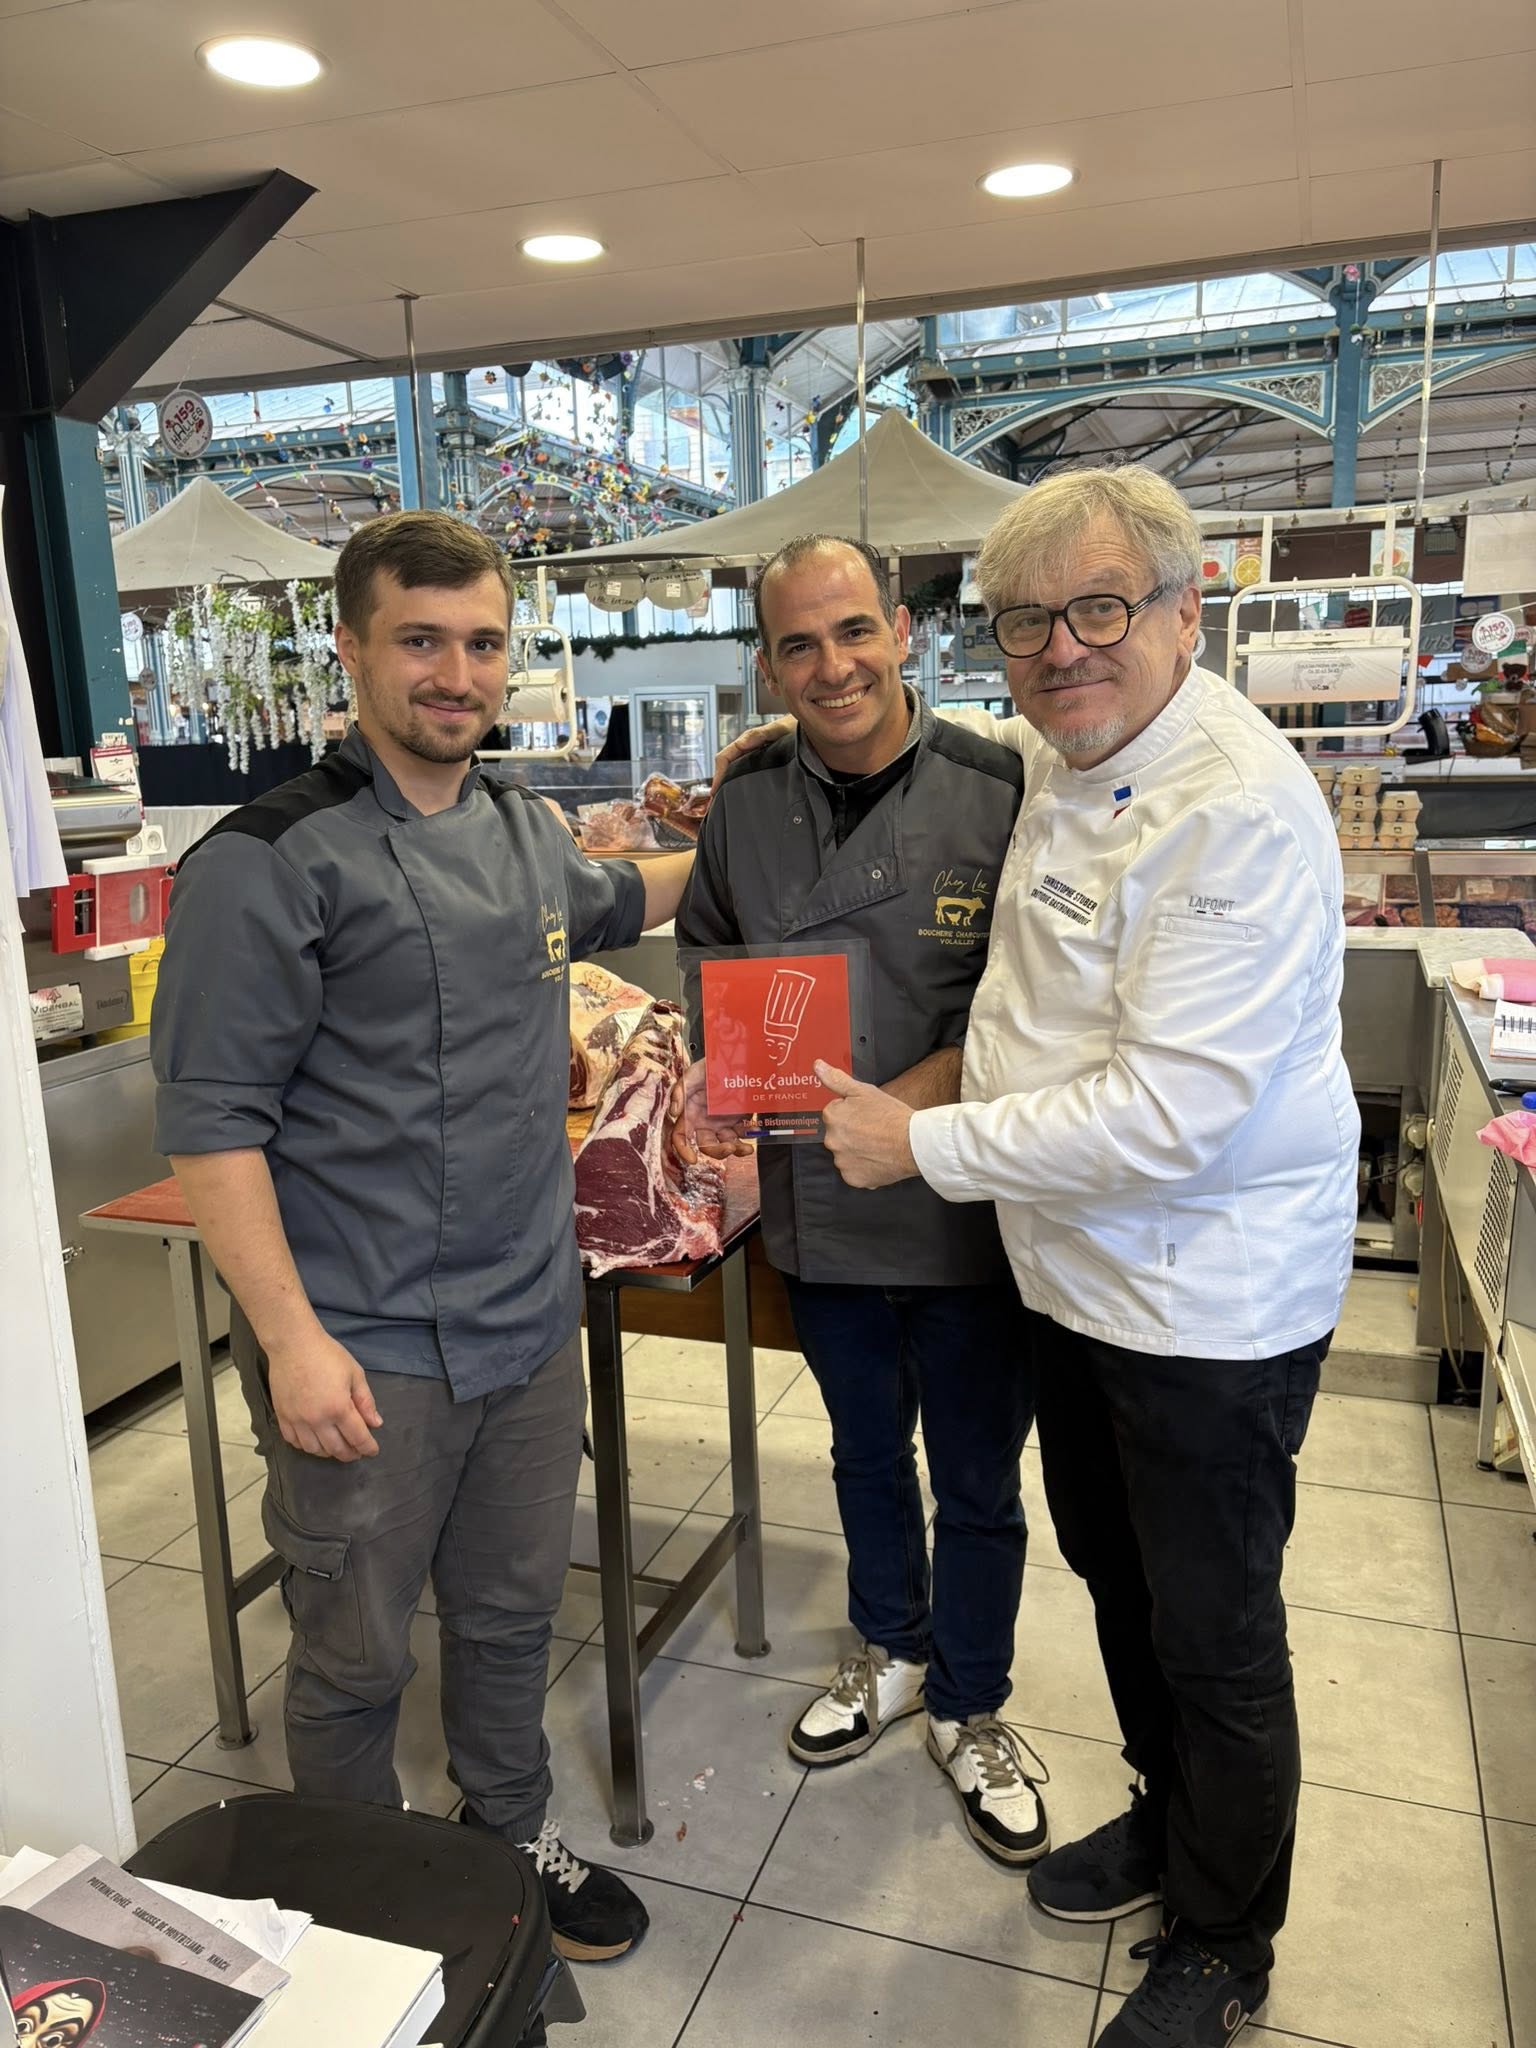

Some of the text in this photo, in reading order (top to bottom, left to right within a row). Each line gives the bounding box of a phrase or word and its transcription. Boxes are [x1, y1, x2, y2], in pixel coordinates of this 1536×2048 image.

[174, 400, 195, 424] 150
[1043, 874, 1098, 911] CHRISTOPHE STUBER
[1048, 898, 1092, 926] GASTRONOMIQUE
[1189, 895, 1235, 911] LAFONT
[918, 928, 953, 937] BOUCHERIE
[723, 1074, 762, 1089] tables
[777, 1073, 822, 1088] auberg
[768, 1092, 808, 1101] FRANCE
[87, 1876, 116, 1898] POITRINE
[155, 1921, 168, 1932] DE
[206, 1953, 231, 1972] KNACK
